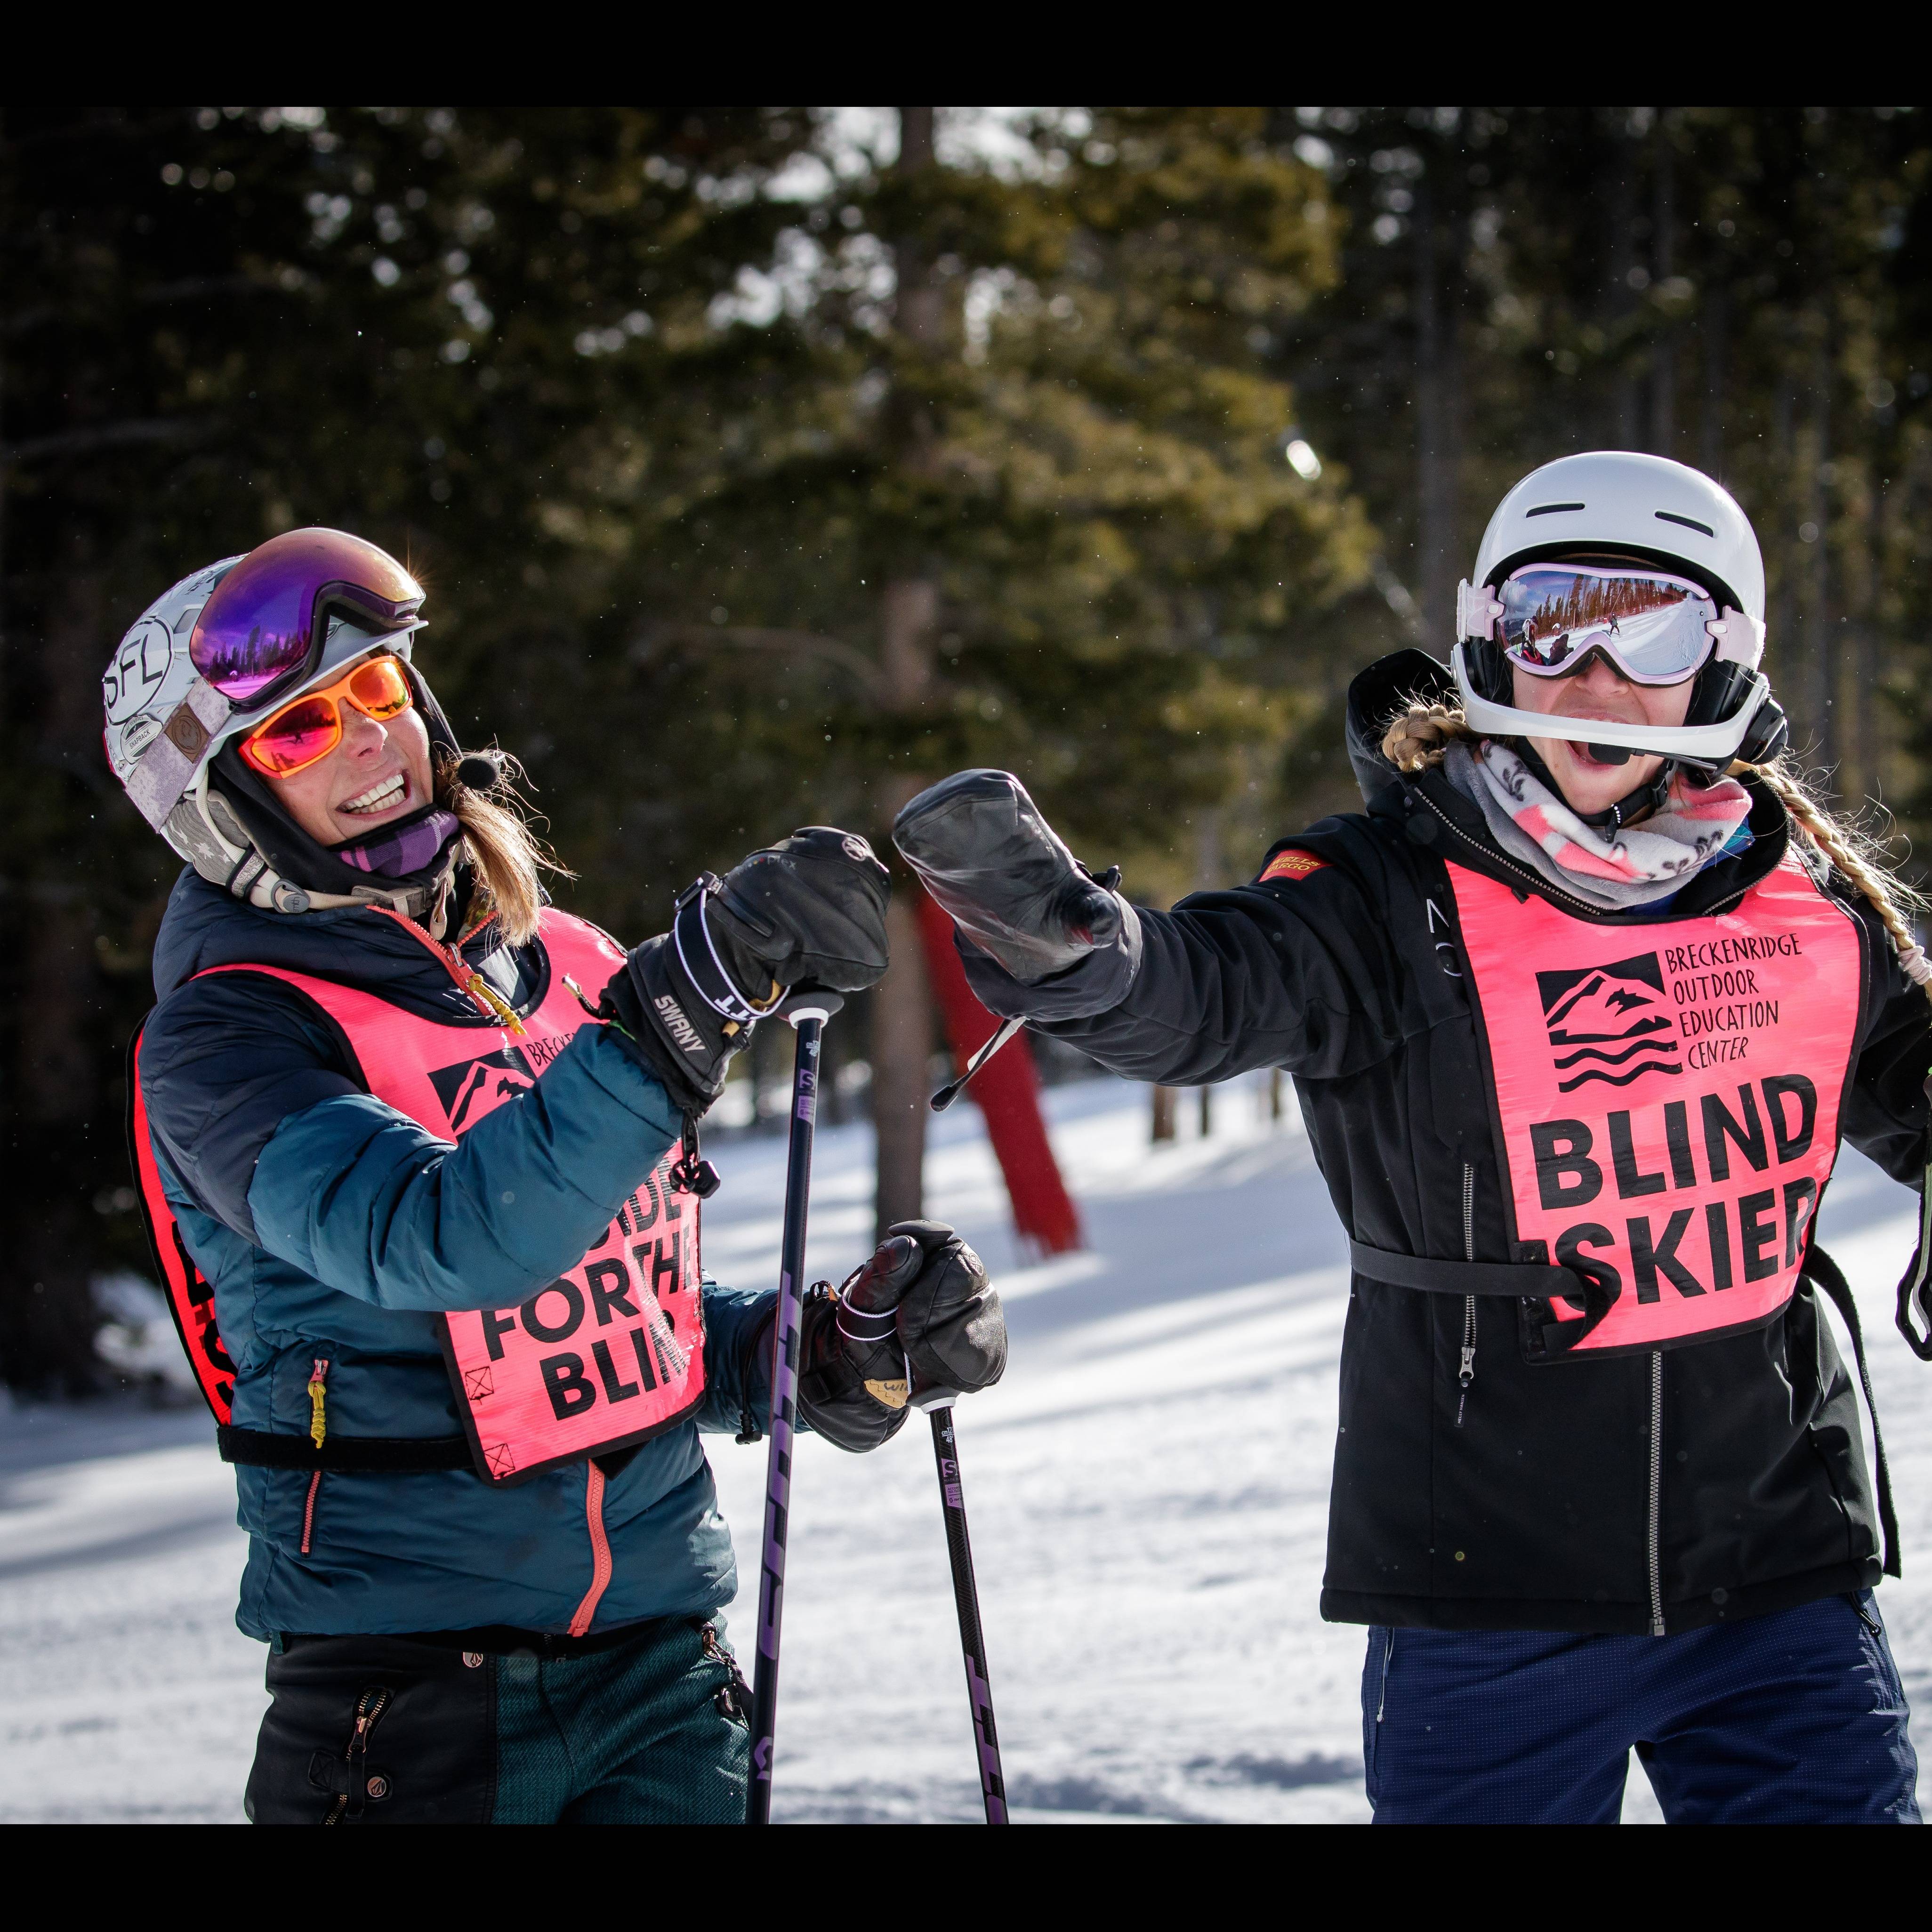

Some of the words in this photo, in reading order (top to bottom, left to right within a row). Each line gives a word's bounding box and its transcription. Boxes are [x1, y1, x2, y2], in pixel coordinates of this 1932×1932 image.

[104, 634, 163, 709] SFL
[129, 729, 151, 749] SNAPBACK
[1665, 934, 1803, 974] BRECKENRIDGE
[1674, 971, 1760, 1006] OUTDOOR
[655, 994, 706, 1052] SWANY
[1680, 1001, 1779, 1038] EDUCATION
[525, 1032, 576, 1067] BRECK
[1688, 1037, 1749, 1071] CENTER
[1529, 1074, 1819, 1210] BLIND
[1554, 1176, 1818, 1312] SKIER
[480, 1257, 641, 1362] FOR
[632, 1224, 692, 1300] THE
[539, 1309, 687, 1421] BLIN
